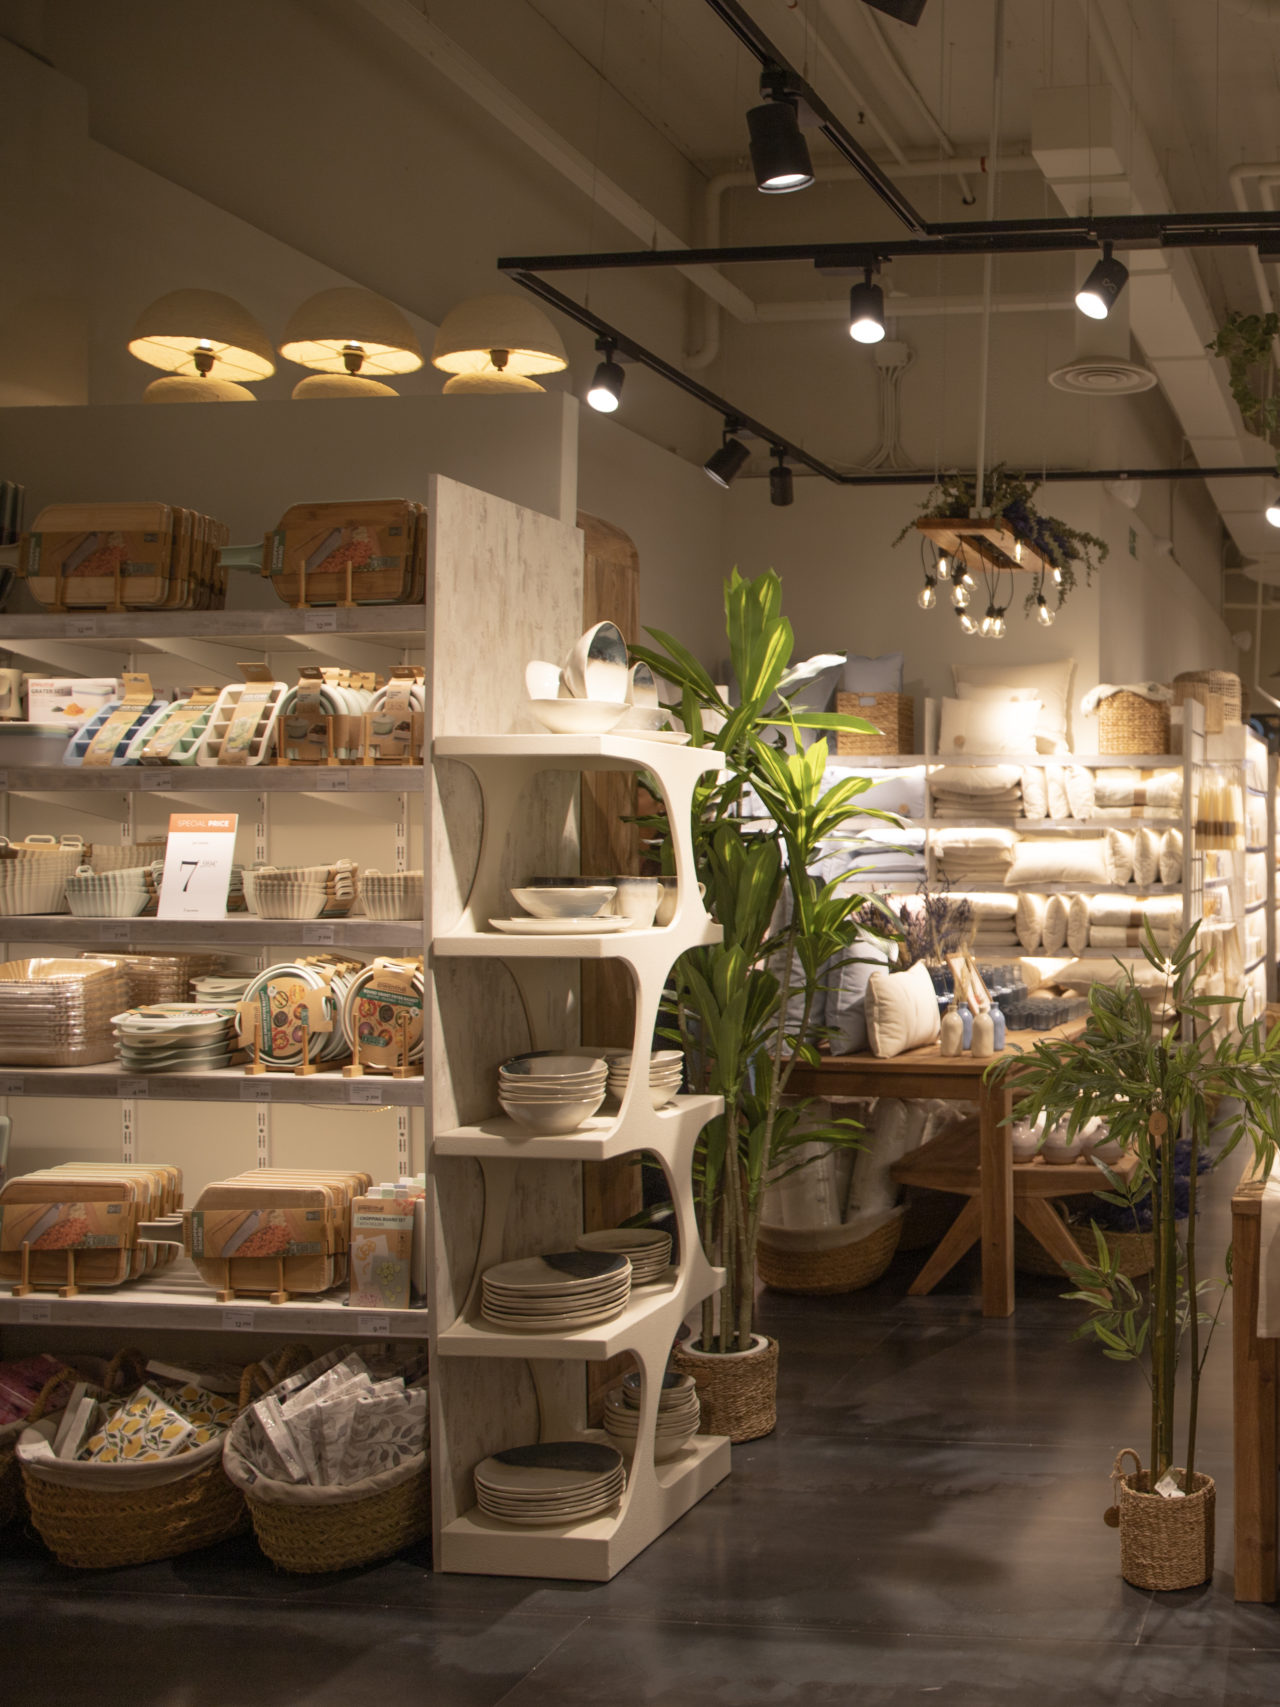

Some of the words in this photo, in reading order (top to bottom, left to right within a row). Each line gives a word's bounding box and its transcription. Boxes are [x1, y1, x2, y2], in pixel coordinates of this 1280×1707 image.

[177, 819, 206, 827] SPECIAL
[207, 819, 230, 828] PRICE
[180, 860, 200, 893] 7
